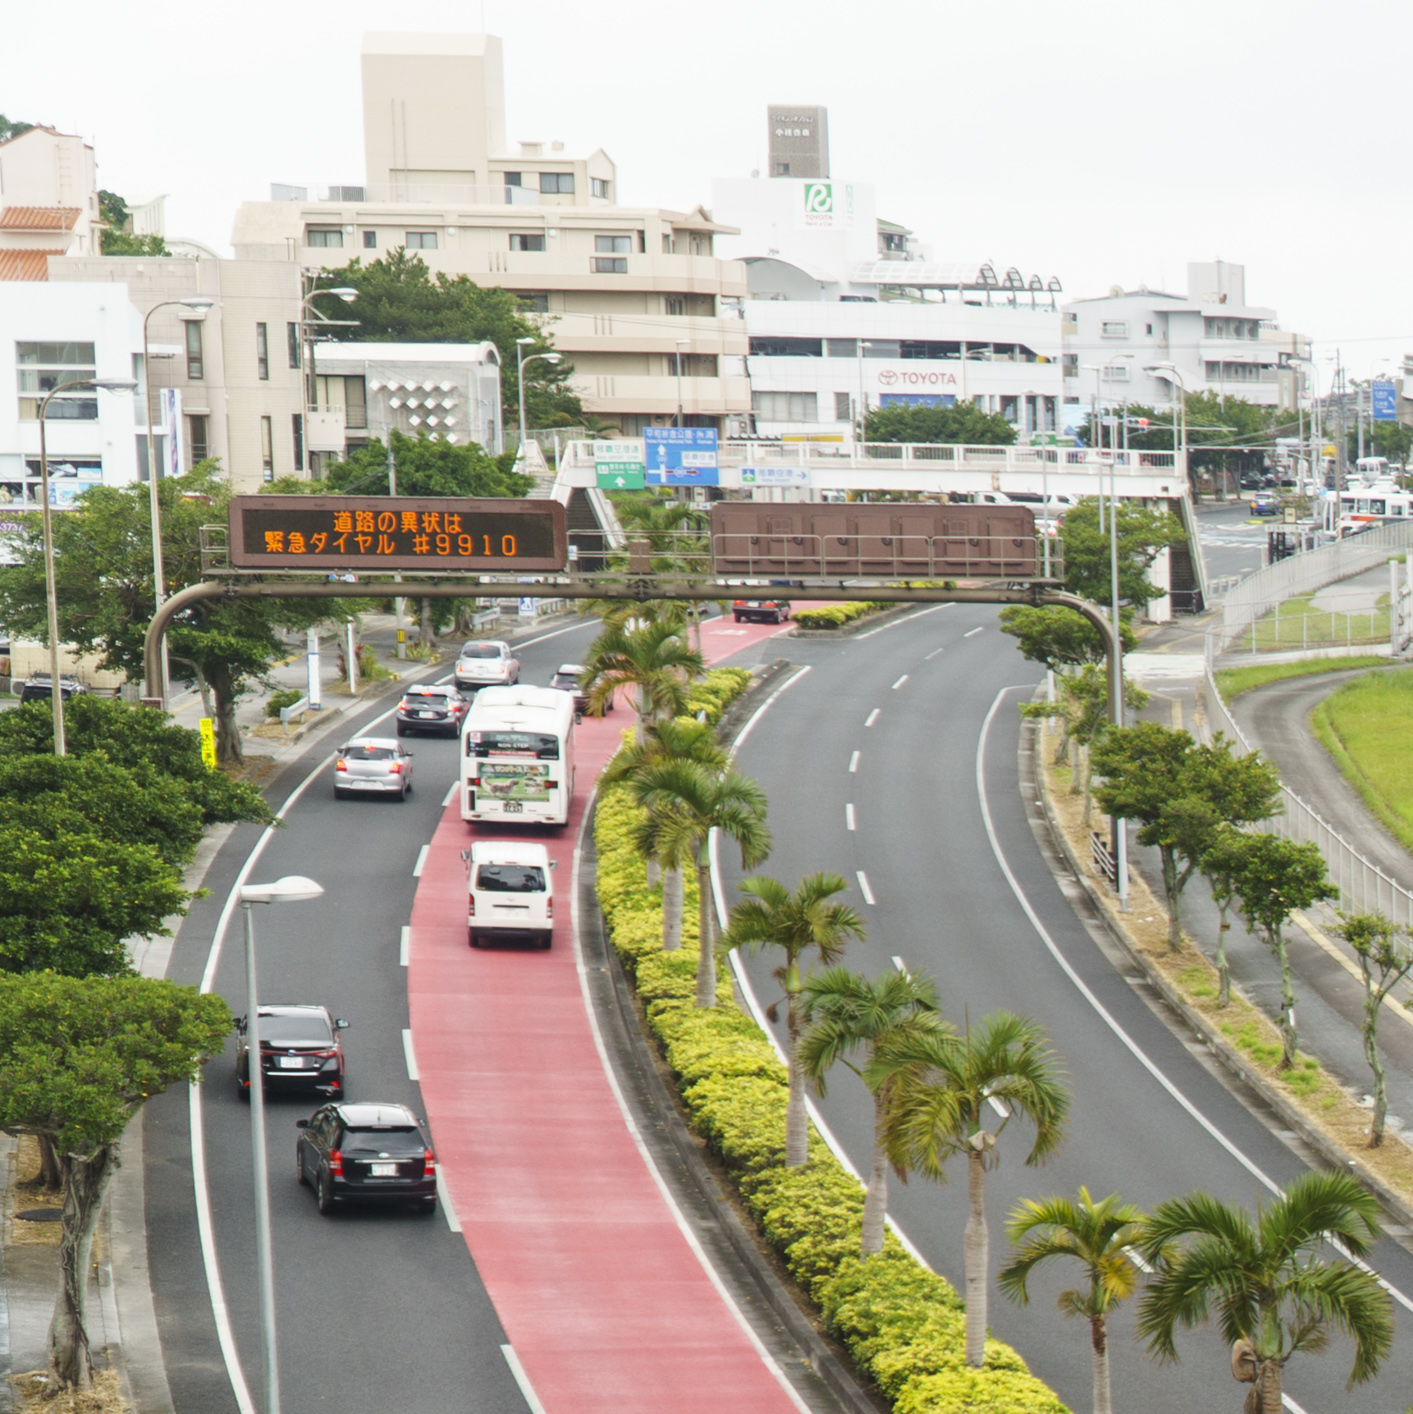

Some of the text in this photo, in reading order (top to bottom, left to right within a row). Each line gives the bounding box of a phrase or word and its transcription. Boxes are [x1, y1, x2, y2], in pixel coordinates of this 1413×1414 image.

[805, 213, 833, 221] TOYOTA
[900, 372, 957, 385] TOYOTA
[333, 511, 462, 534] 道路の異状は
[264, 531, 395, 555] 緊急ダイヤル
